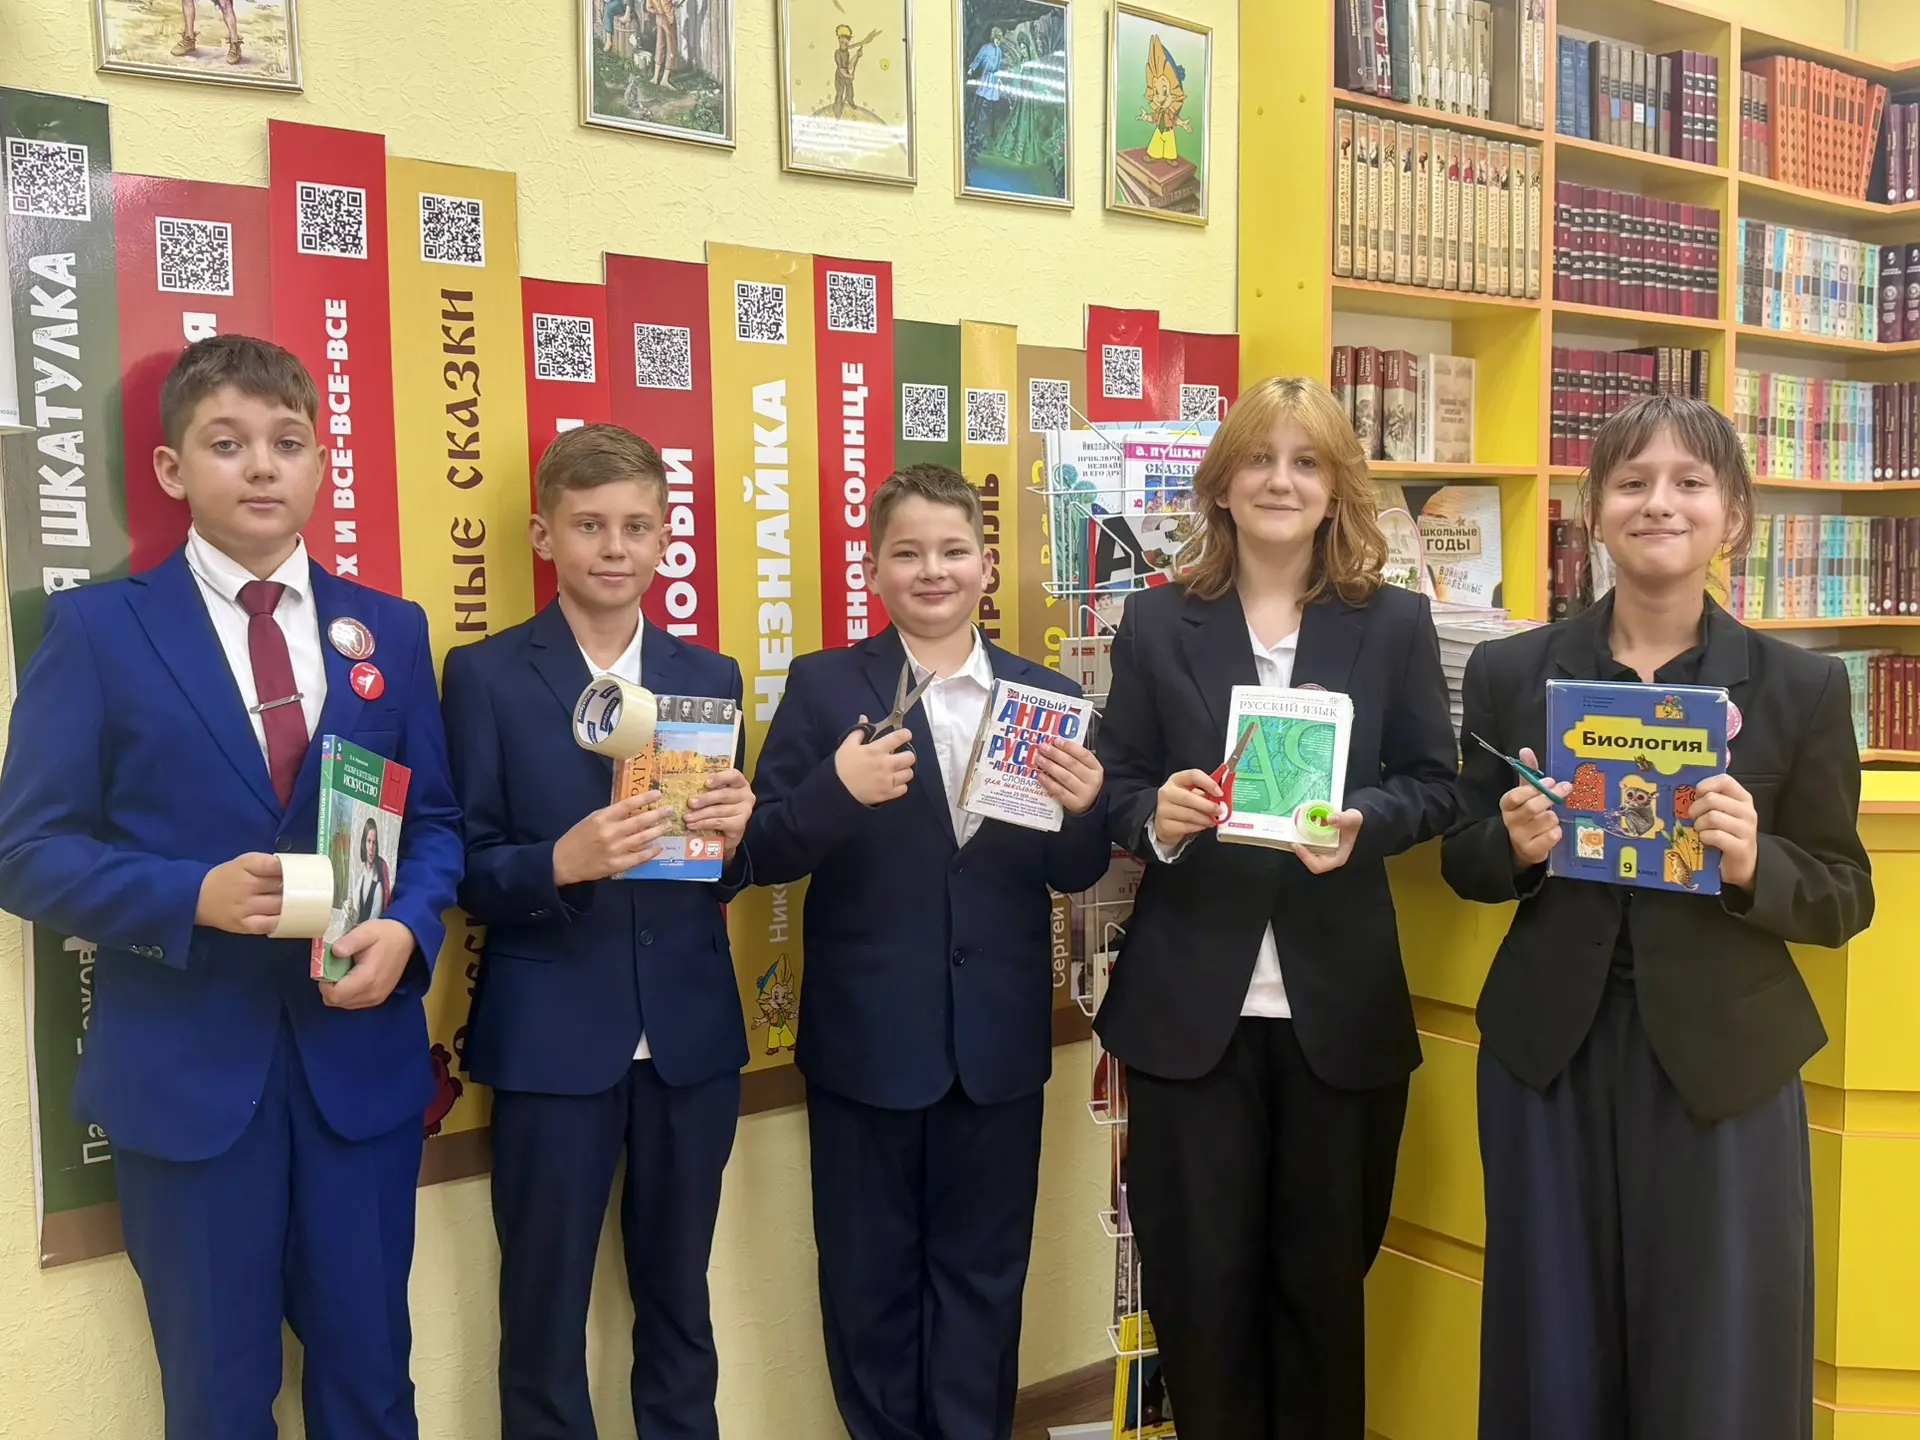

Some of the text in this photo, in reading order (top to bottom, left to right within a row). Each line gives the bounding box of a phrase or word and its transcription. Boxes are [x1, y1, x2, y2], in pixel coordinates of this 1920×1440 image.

[28, 252, 91, 548] ШКАТУЛКА
[324, 298, 356, 509] ВСЕ-ВСЕ-ВСЕ
[441, 289, 488, 633] НЫЕ СКАЗКИ
[1106, 470, 1120, 478] ДРУ
[839, 361, 869, 650] ЕНОЕ СОЛНЦЕ
[335, 521, 356, 544] И
[743, 379, 793, 721] НЕЗНАЙКА
[1426, 538, 1470, 552] ГОДЫ
[1020, 693, 1068, 712] НОВЫЙ
[1239, 700, 1338, 718] РУССКИЙ ЯЗЫК
[1000, 725, 1058, 745] -РУССКИ
[1583, 731, 1702, 753] Биология
[987, 734, 1040, 769] РУСС
[343, 773, 378, 798] ИСКУССТВО
[1002, 775, 1042, 789] СЛОВАРЬ
[689, 837, 704, 857] 9
[1623, 862, 1632, 873] 9
[768, 884, 788, 944] Ник
